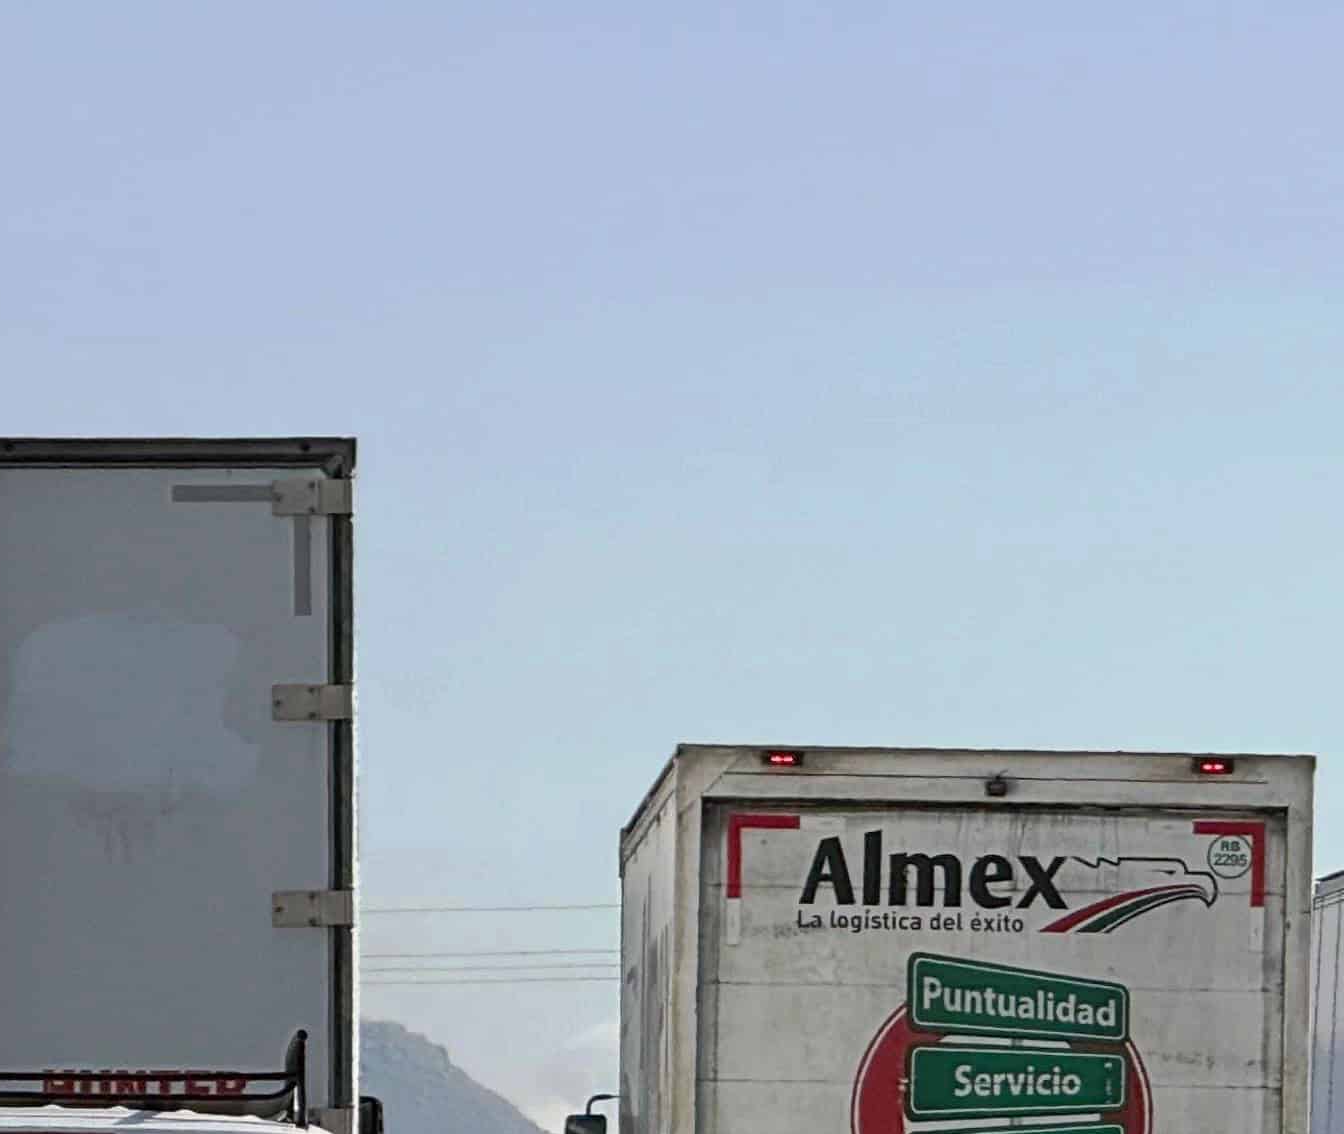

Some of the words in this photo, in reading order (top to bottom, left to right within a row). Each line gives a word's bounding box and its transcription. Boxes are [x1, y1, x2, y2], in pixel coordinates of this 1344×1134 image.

[799, 829, 1069, 909] Almex
[797, 910, 823, 929] La
[830, 908, 923, 933] logística
[930, 912, 963, 931] del
[970, 911, 1024, 932] éxito
[922, 976, 1117, 1027] Puntualidad
[954, 1065, 1082, 1097] Servicio
